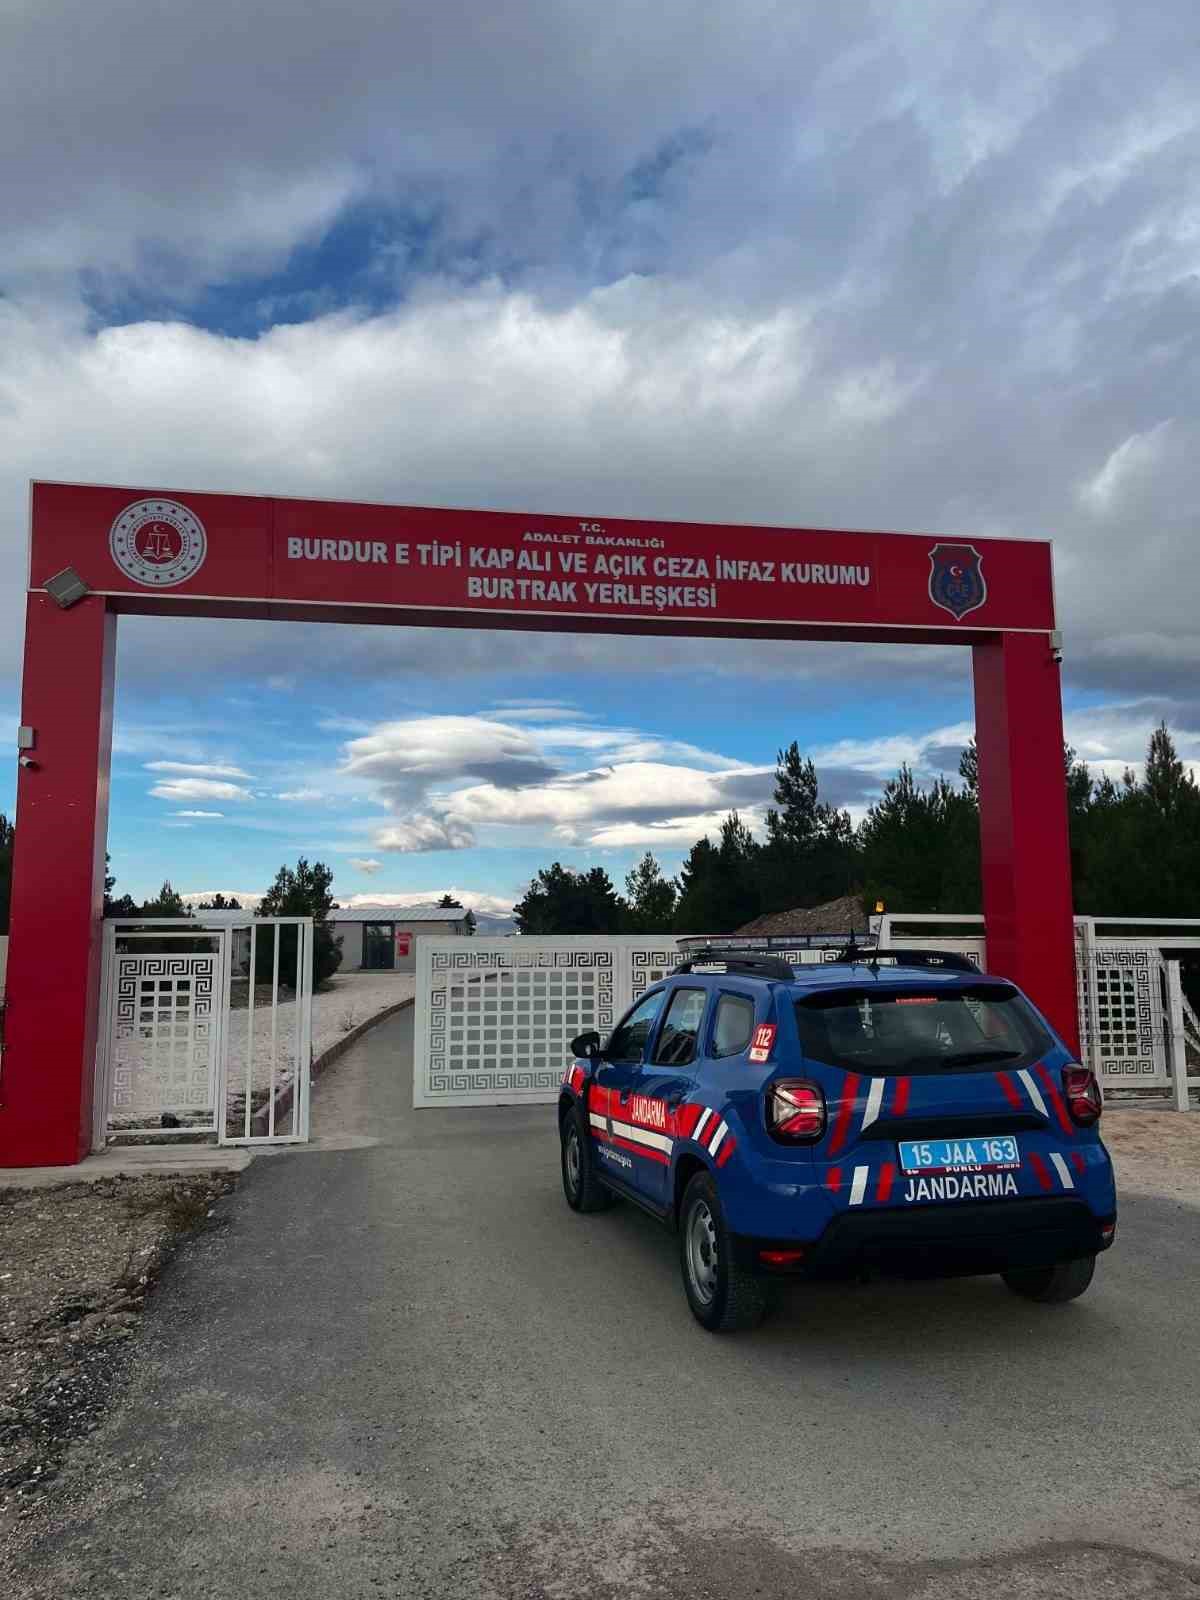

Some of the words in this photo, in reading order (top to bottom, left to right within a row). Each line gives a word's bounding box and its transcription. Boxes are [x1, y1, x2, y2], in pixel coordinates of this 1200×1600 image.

[522, 532, 581, 544] ADALET
[585, 536, 665, 549] BAKANLIĞI
[578, 522, 606, 533] T.C.
[287, 536, 389, 564] BURDUR
[395, 543, 410, 564] E
[416, 539, 463, 567] TİPİ
[468, 546, 552, 572] KAPALI
[559, 551, 587, 573] VE
[594, 553, 647, 579] AÇIK
[653, 556, 710, 579] CEZA
[715, 555, 776, 582] İNFAZ
[781, 562, 870, 586] KURUMU
[467, 576, 578, 602] BURTRAK
[584, 582, 717, 612] YERLEŞKESİ
[755, 1028, 772, 1047] 112
[631, 1095, 666, 1129] JANDARMA
[911, 1144, 933, 1166] 15
[940, 1142, 978, 1164] JAA
[982, 1139, 1016, 1162] 163
[904, 1173, 1019, 1202] JANDARMA
